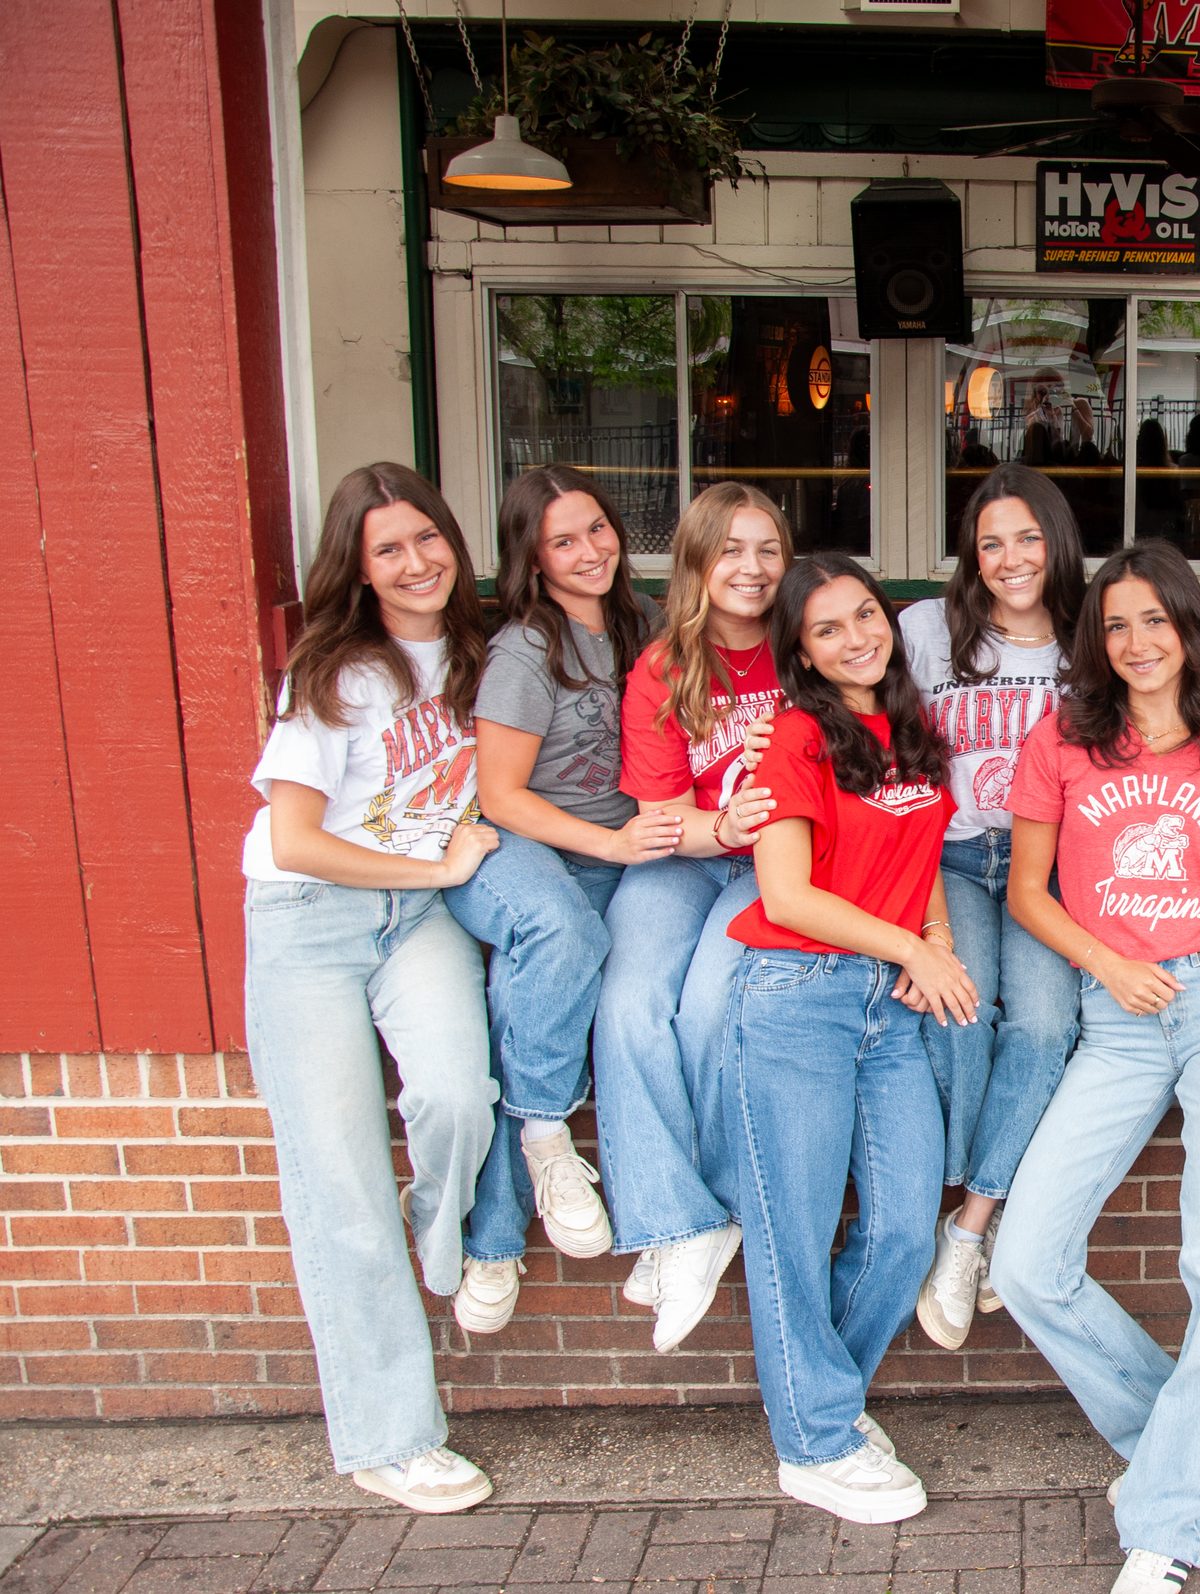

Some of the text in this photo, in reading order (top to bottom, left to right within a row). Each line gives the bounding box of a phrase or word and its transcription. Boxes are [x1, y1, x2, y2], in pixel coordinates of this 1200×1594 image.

[1156, 222, 1195, 239] OIL
[1043, 249, 1196, 264] SUPER-REFINED PENNSYLVANIA
[897, 320, 927, 330] YAMAHA
[1144, 849, 1186, 879] M
